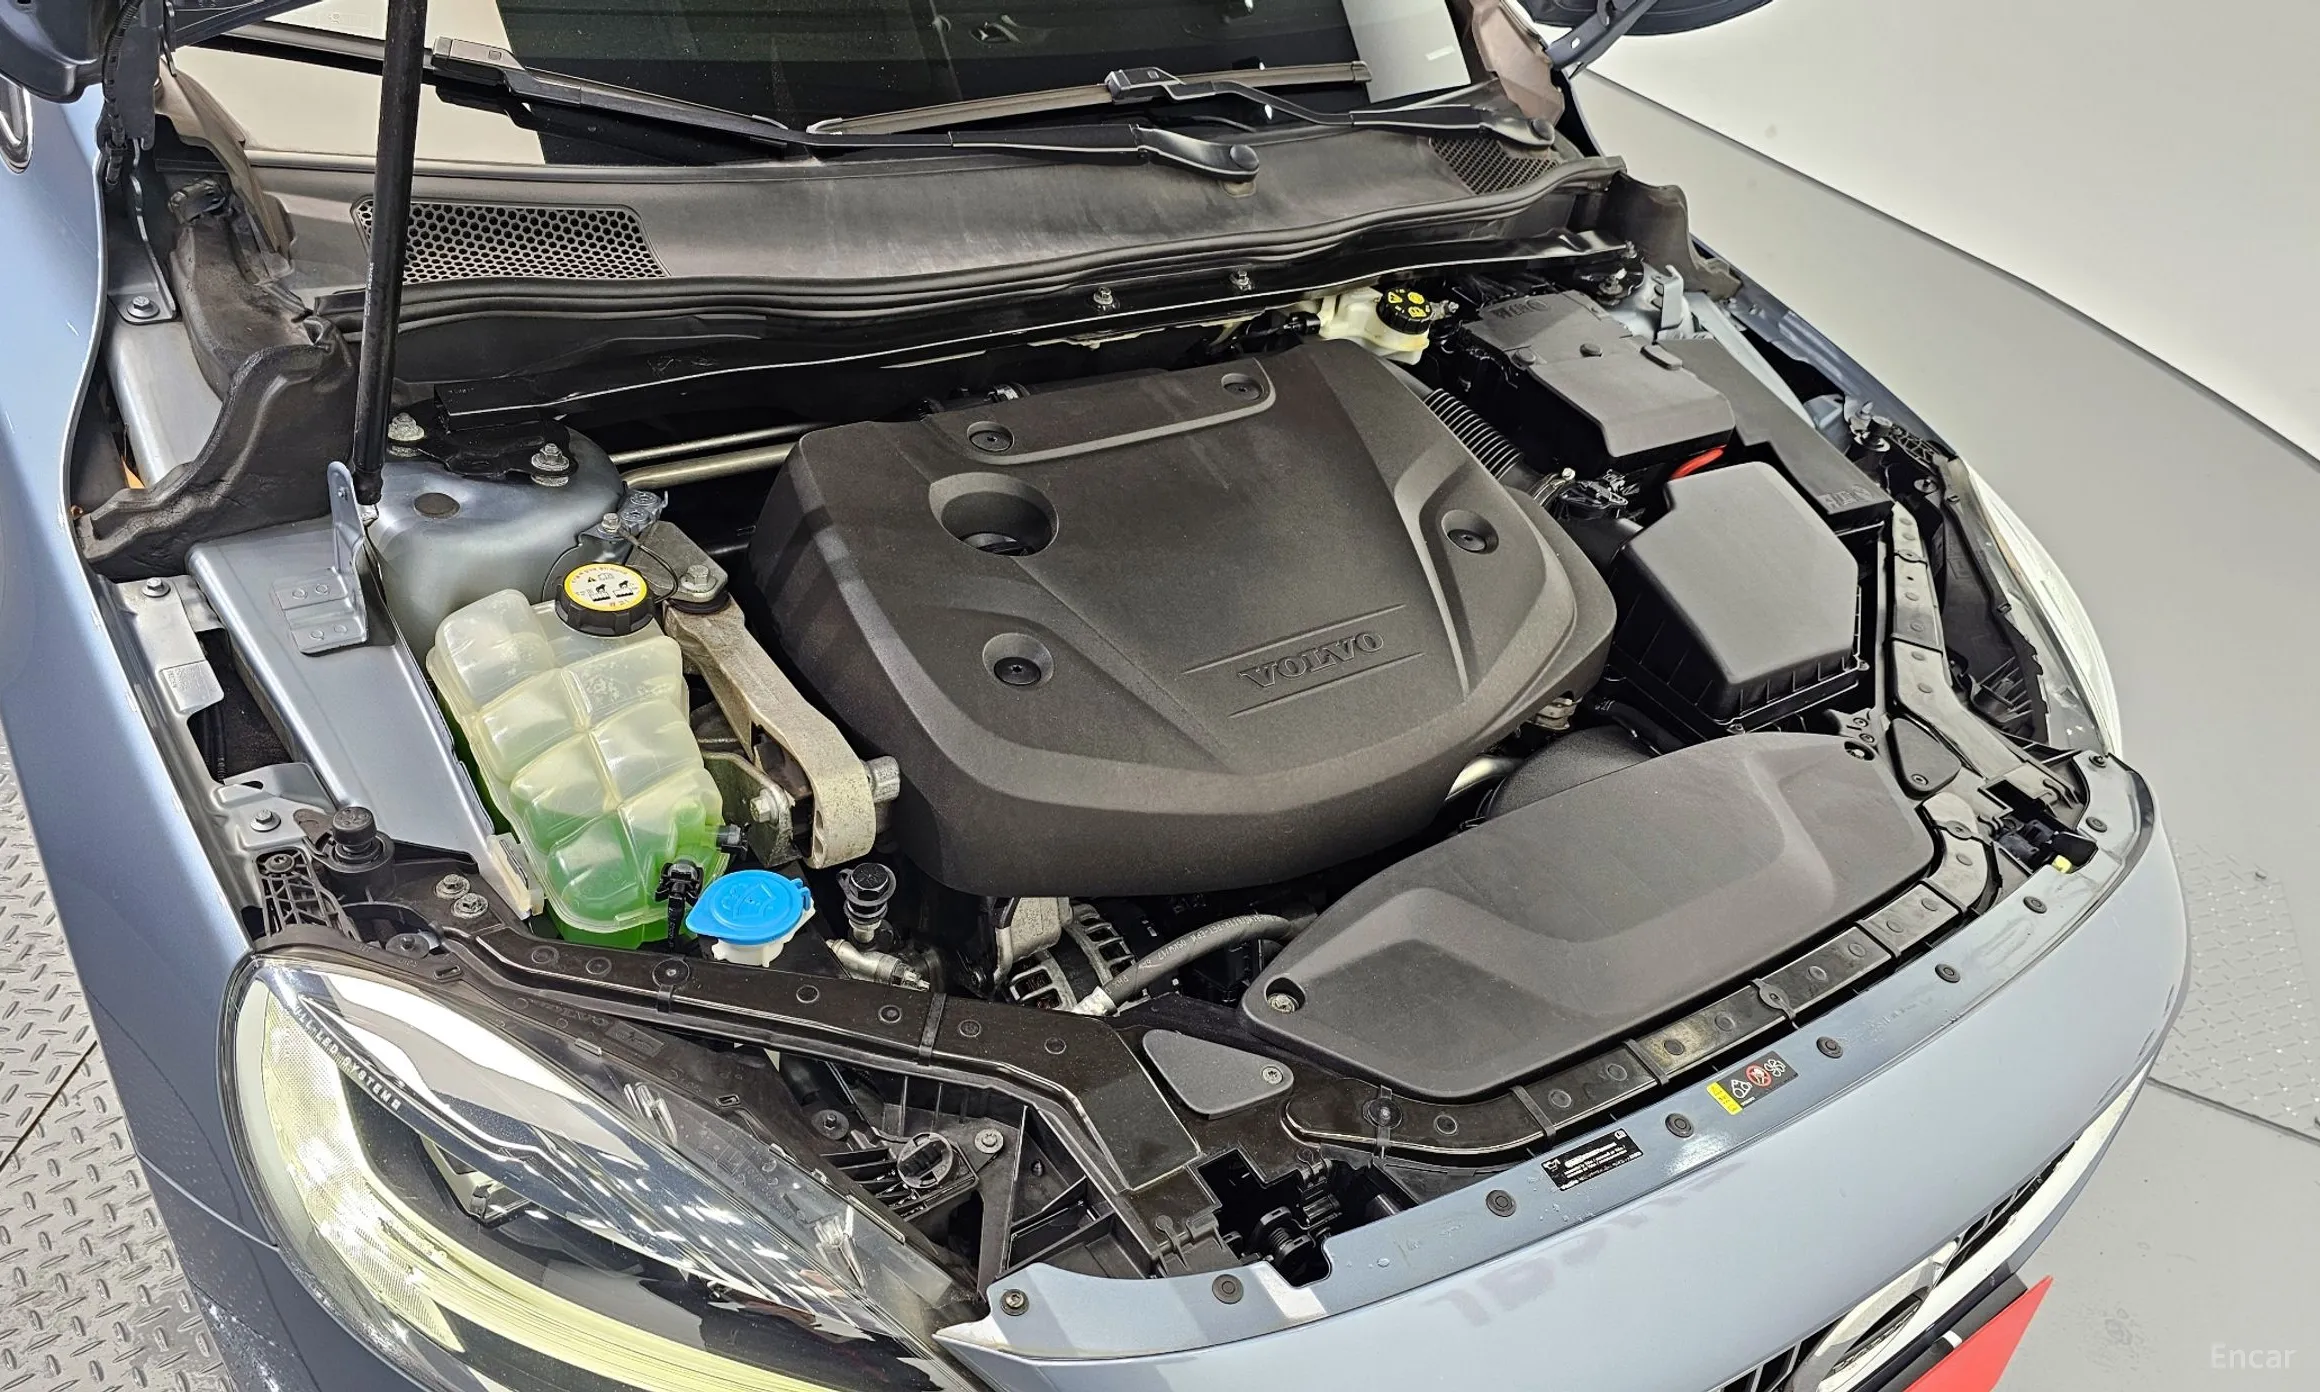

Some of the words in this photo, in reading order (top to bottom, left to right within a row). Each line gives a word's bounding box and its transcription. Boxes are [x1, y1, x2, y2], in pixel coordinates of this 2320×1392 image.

[1238, 631, 1384, 688] VOLVO
[316, 1030, 339, 1055] LED
[342, 1056, 402, 1111] SYSTEMS
